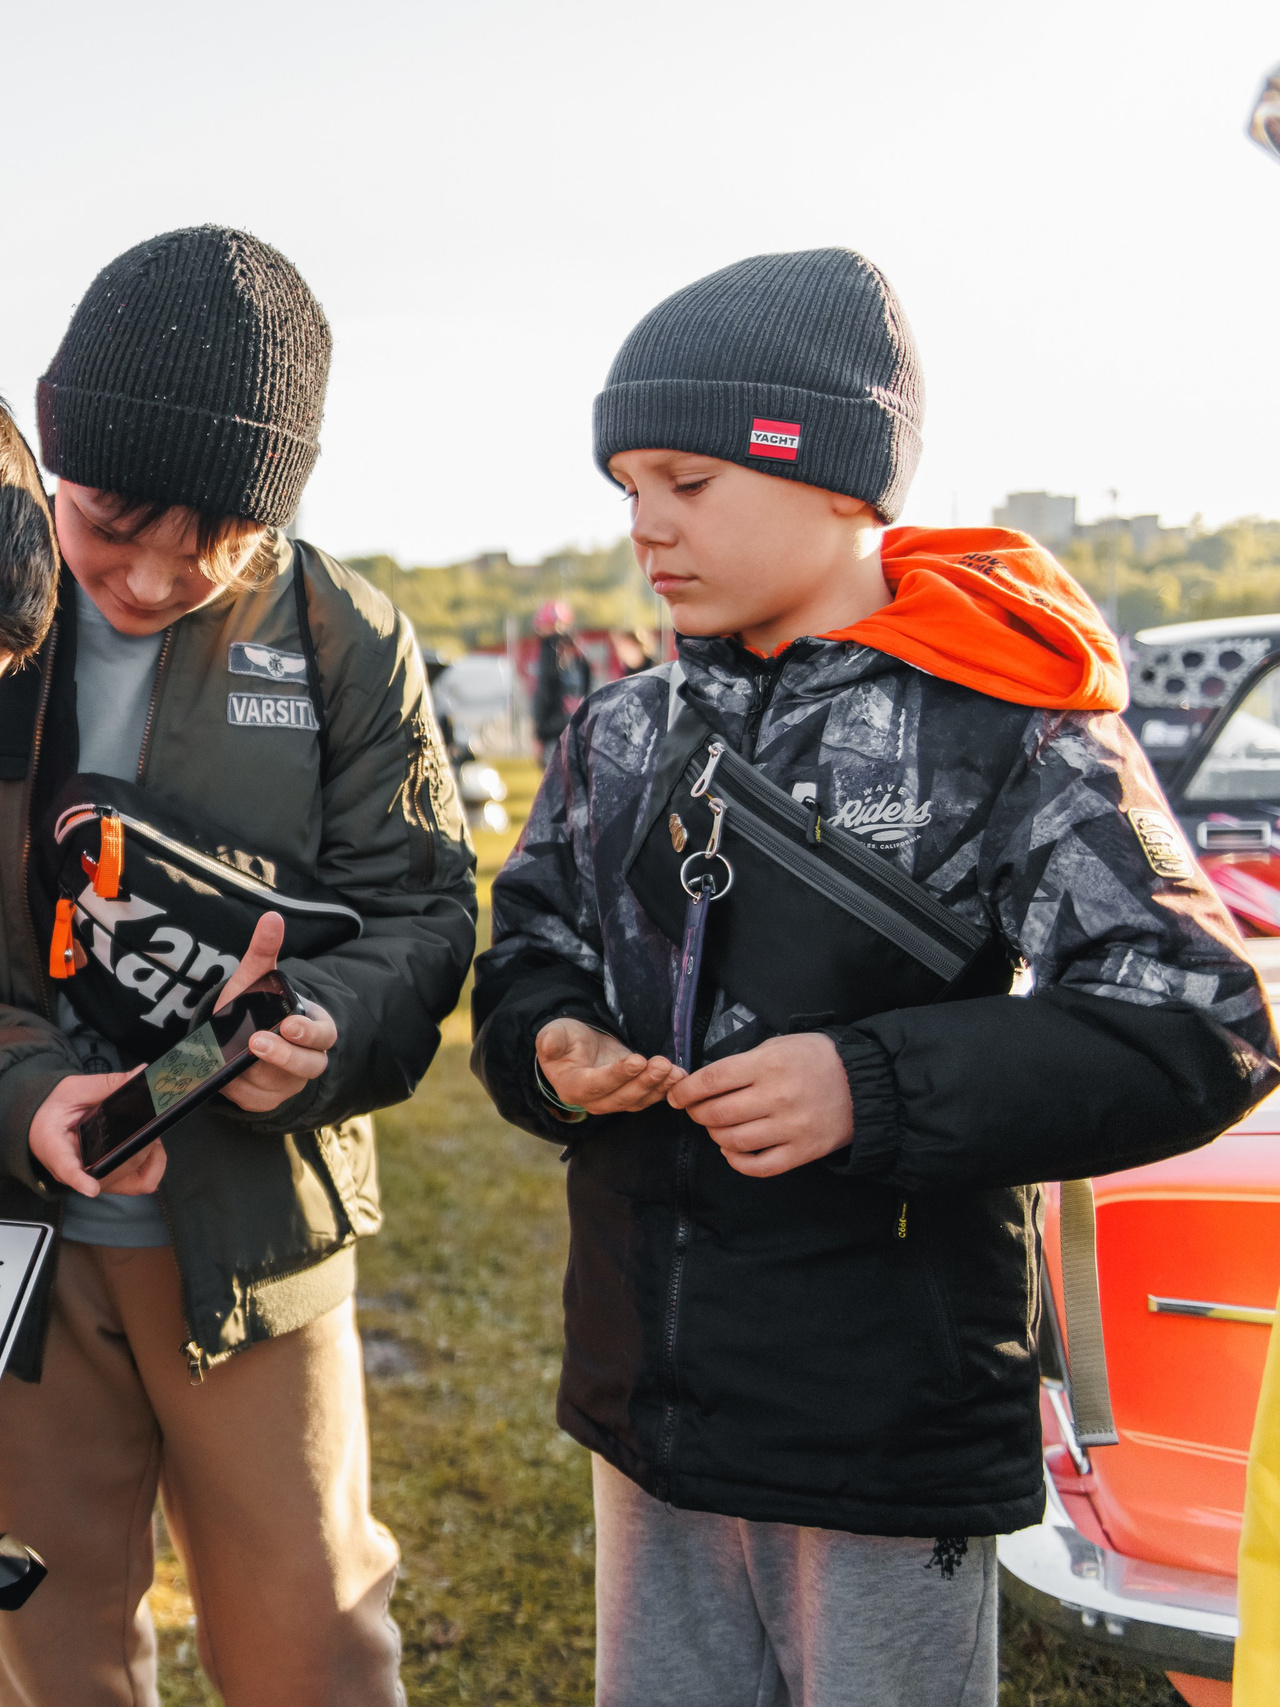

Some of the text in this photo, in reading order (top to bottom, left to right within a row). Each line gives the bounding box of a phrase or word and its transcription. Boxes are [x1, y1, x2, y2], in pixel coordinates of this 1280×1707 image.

[753, 432, 797, 446] YACHT
[862, 783, 907, 796] WAVE
[826, 793, 932, 831] Riders
[879, 834, 922, 850] CALIFORNIA
